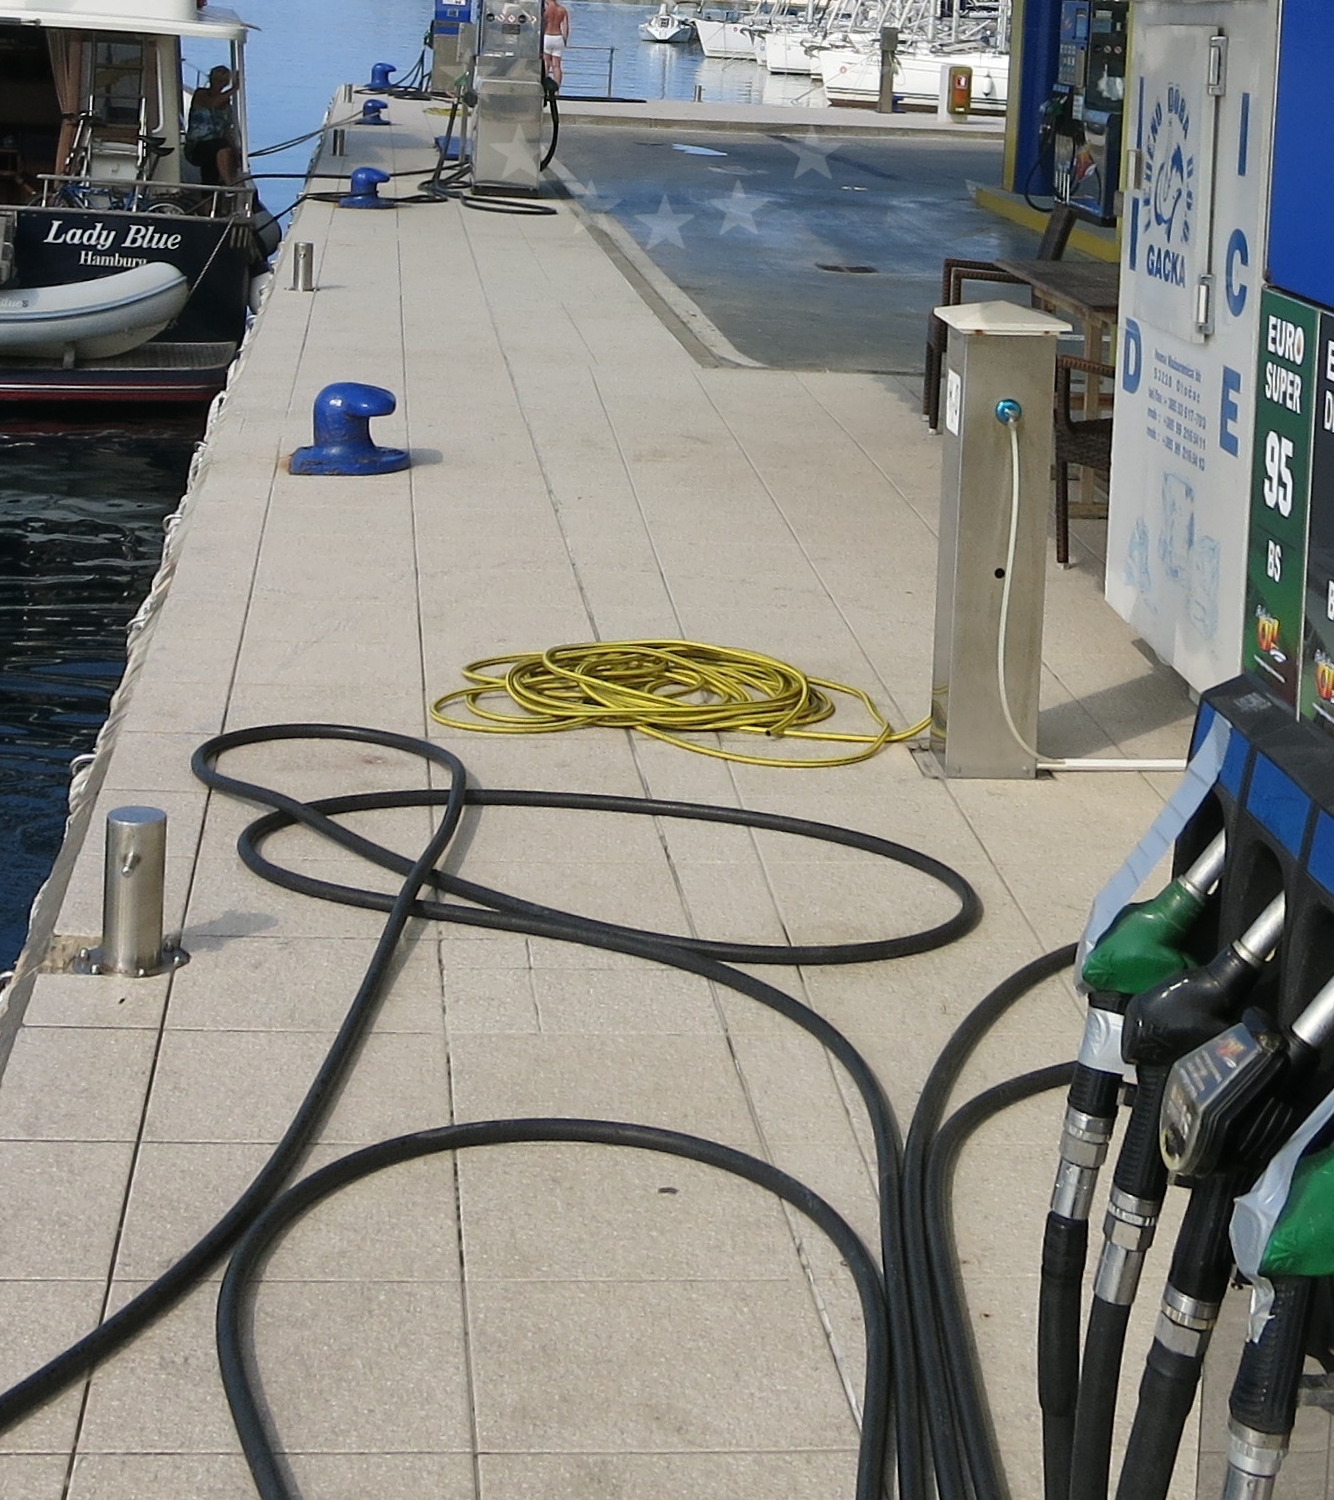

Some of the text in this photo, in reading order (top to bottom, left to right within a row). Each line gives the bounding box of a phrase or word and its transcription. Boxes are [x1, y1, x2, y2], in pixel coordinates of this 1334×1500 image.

[43, 219, 182, 250] Lady Blue
[1146, 244, 1186, 290] GACKA
[1268, 314, 1305, 366] EURO
[1264, 360, 1302, 415] SUPER
[1263, 430, 1294, 518] 95
[1266, 538, 1282, 583] BS
